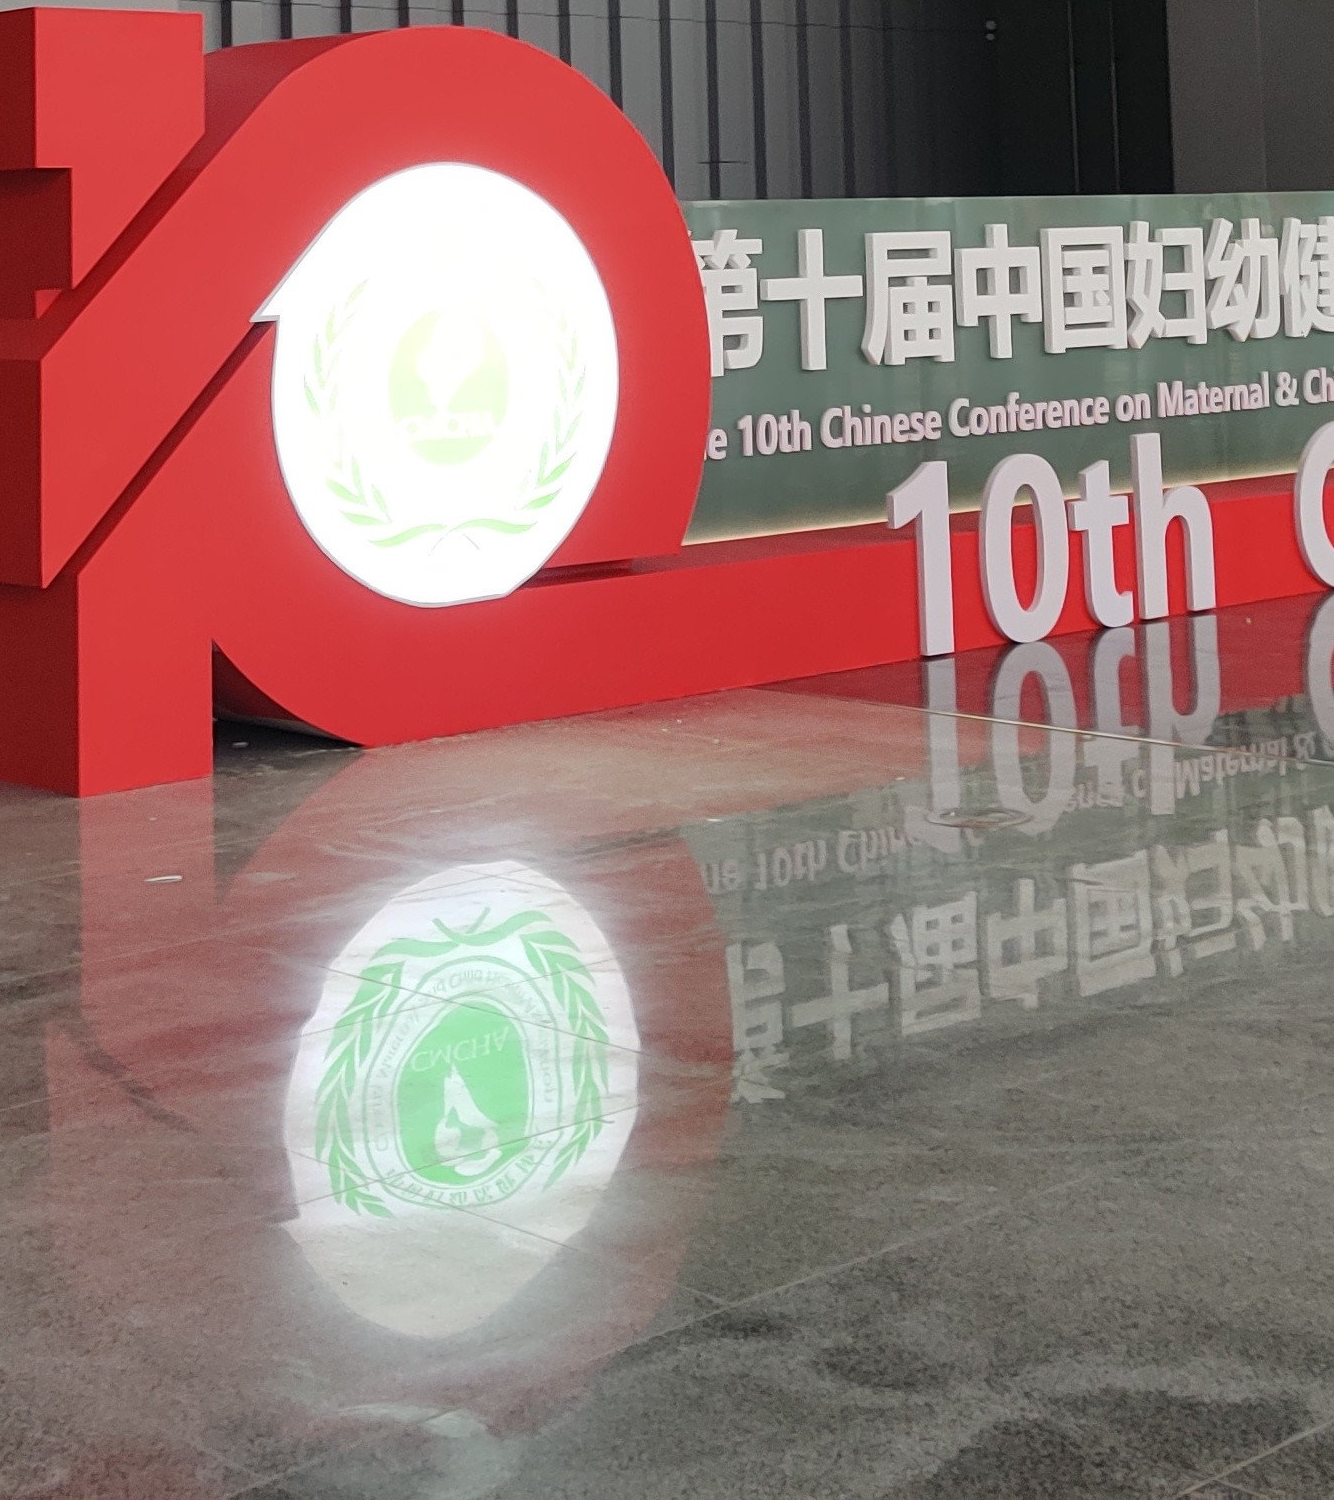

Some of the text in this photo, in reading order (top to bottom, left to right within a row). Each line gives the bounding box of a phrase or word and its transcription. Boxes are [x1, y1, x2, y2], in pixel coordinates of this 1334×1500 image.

[736, 409, 813, 457] 10th
[820, 404, 943, 449] Chinese
[948, 392, 1110, 438] Conference
[1116, 392, 1152, 422] on
[1157, 371, 1270, 418] Maternal
[1275, 371, 1300, 406] &
[886, 432, 1217, 658] 10th
